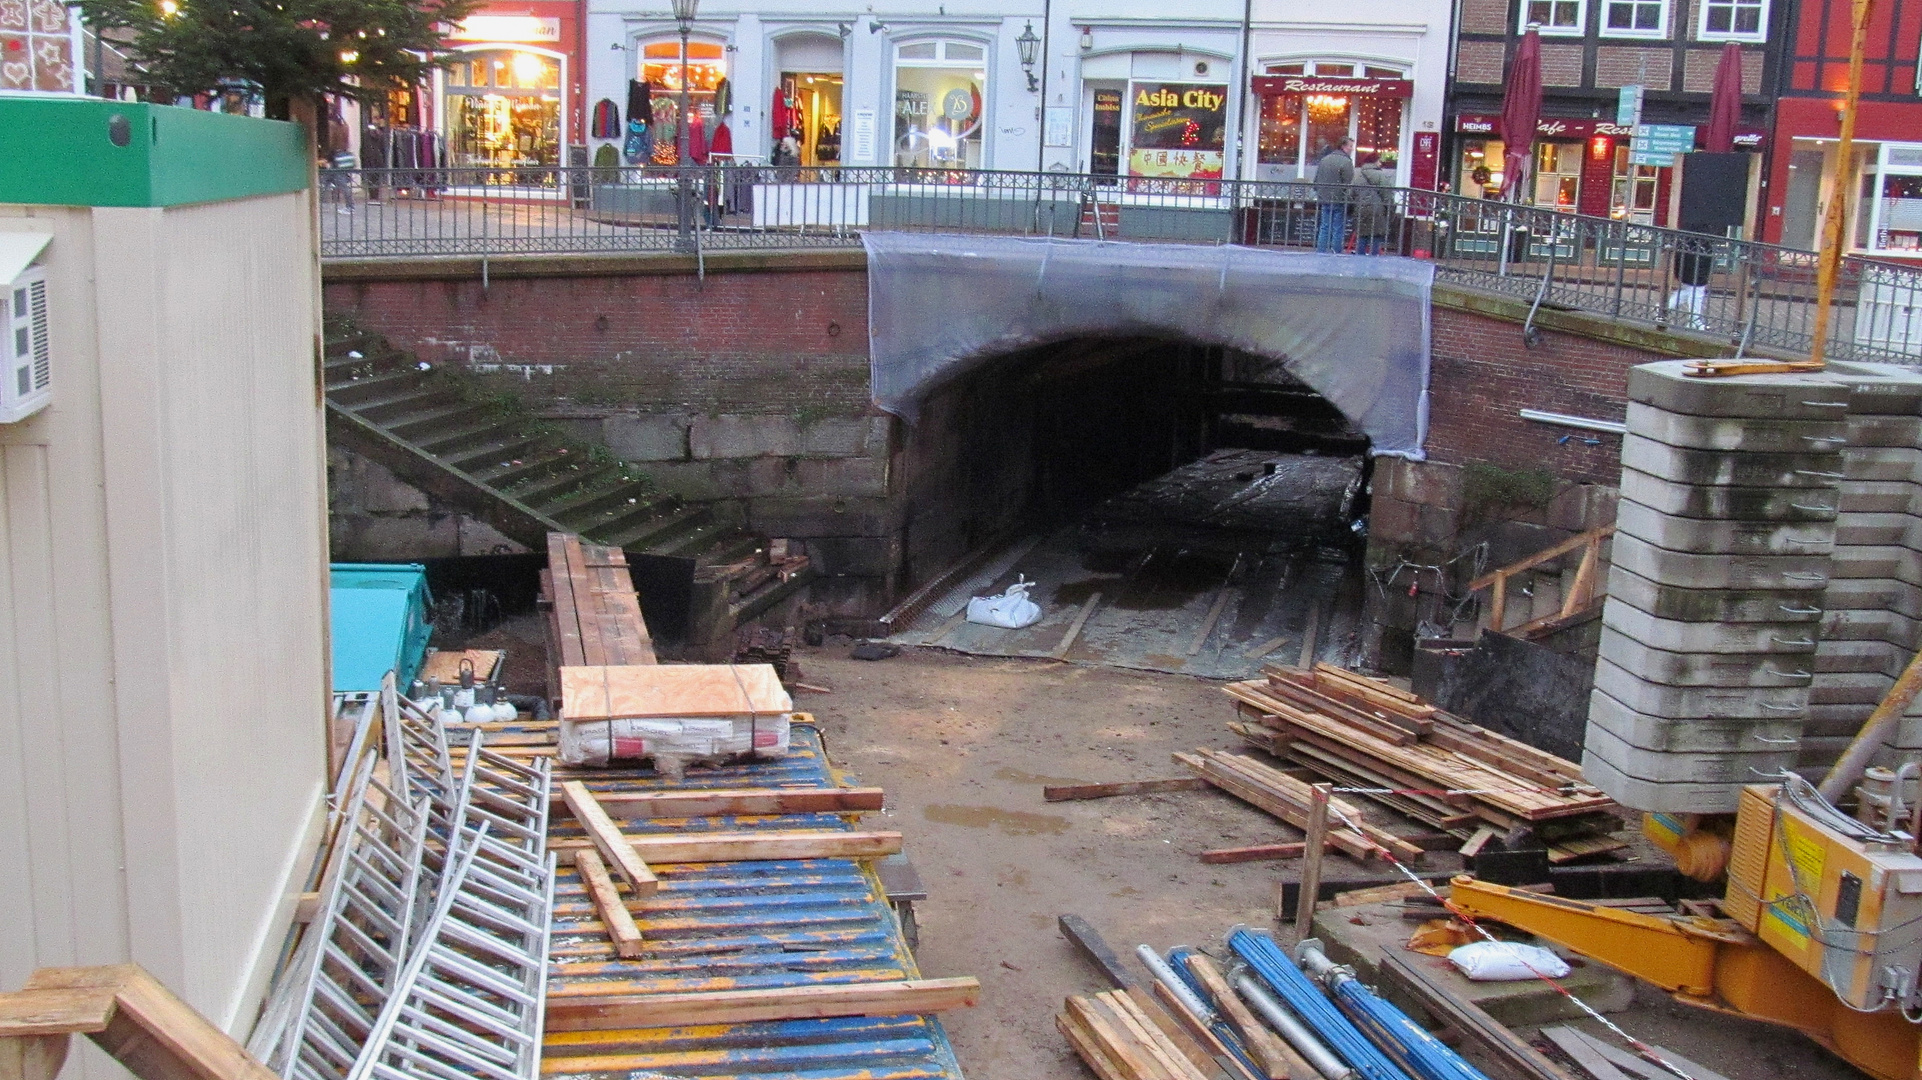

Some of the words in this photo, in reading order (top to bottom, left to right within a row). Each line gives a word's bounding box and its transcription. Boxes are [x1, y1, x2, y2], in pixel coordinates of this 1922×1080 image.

[1284, 79, 1380, 93] Restaurant
[1136, 88, 1179, 107] Asia
[1183, 89, 1224, 112] City
[1462, 122, 1492, 131] HEIMBS
[1537, 119, 1566, 135] afe
